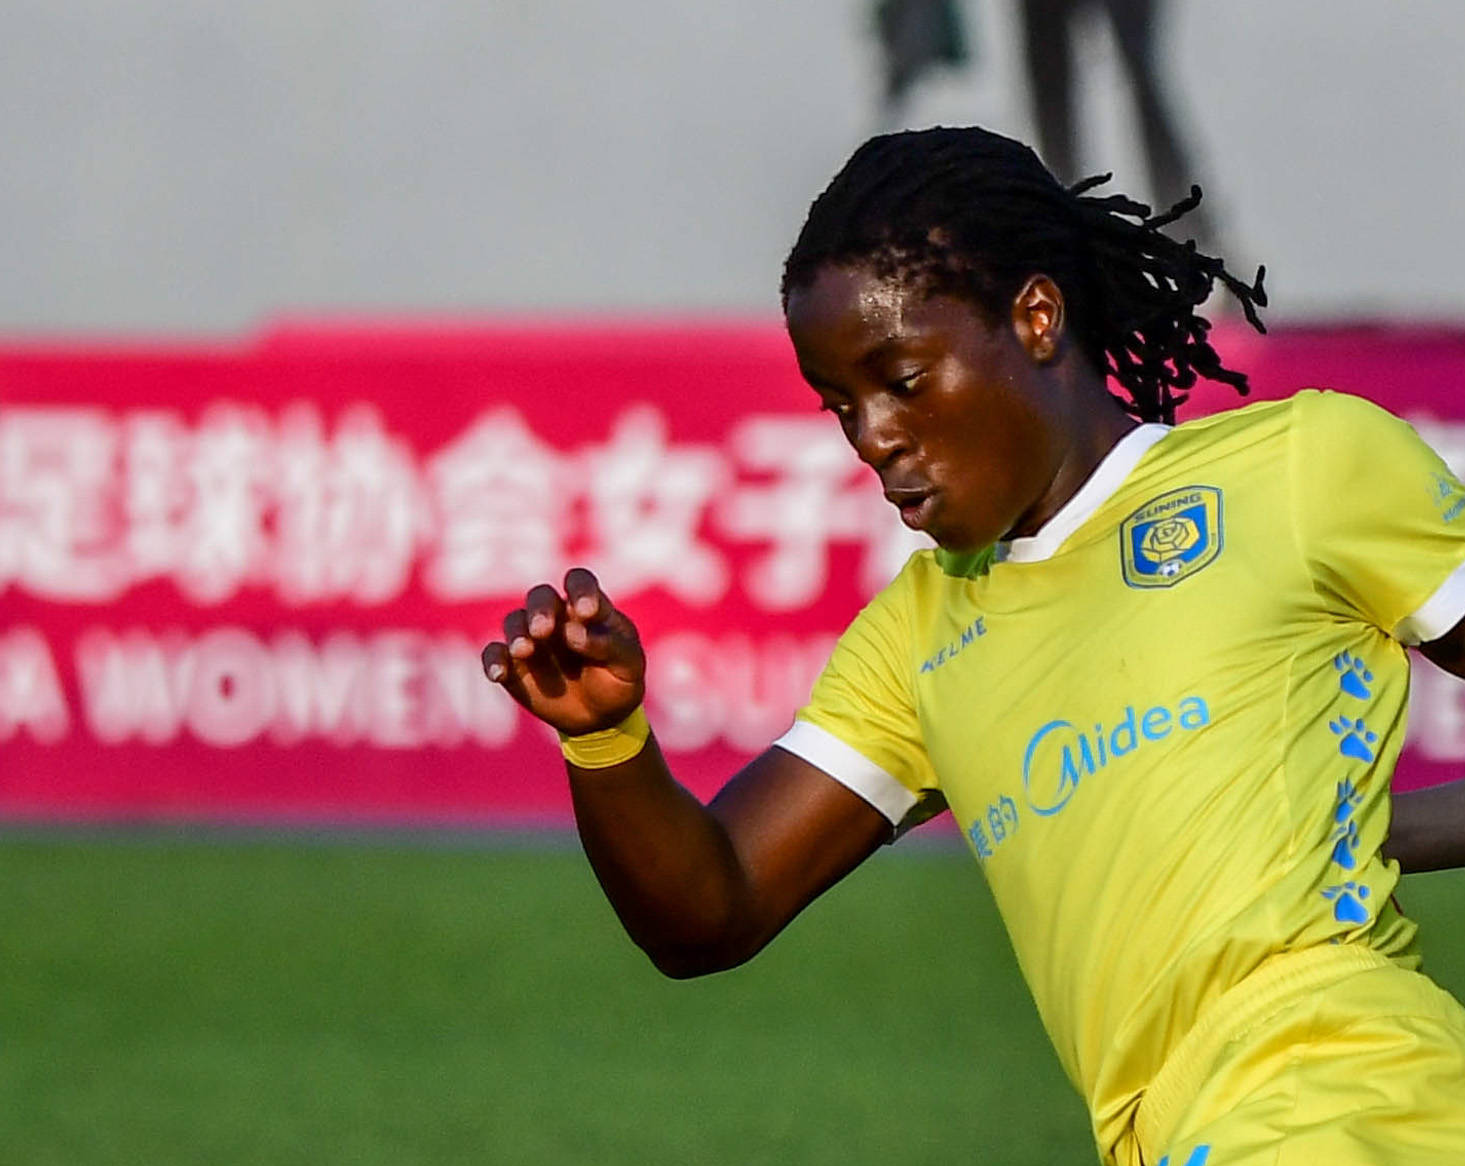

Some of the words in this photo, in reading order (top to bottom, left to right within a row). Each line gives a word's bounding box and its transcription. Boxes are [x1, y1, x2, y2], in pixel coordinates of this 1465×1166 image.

[0, 398, 930, 612] 足球协会女子
[920, 616, 987, 673] KELME
[1022, 695, 1211, 817] Midea
